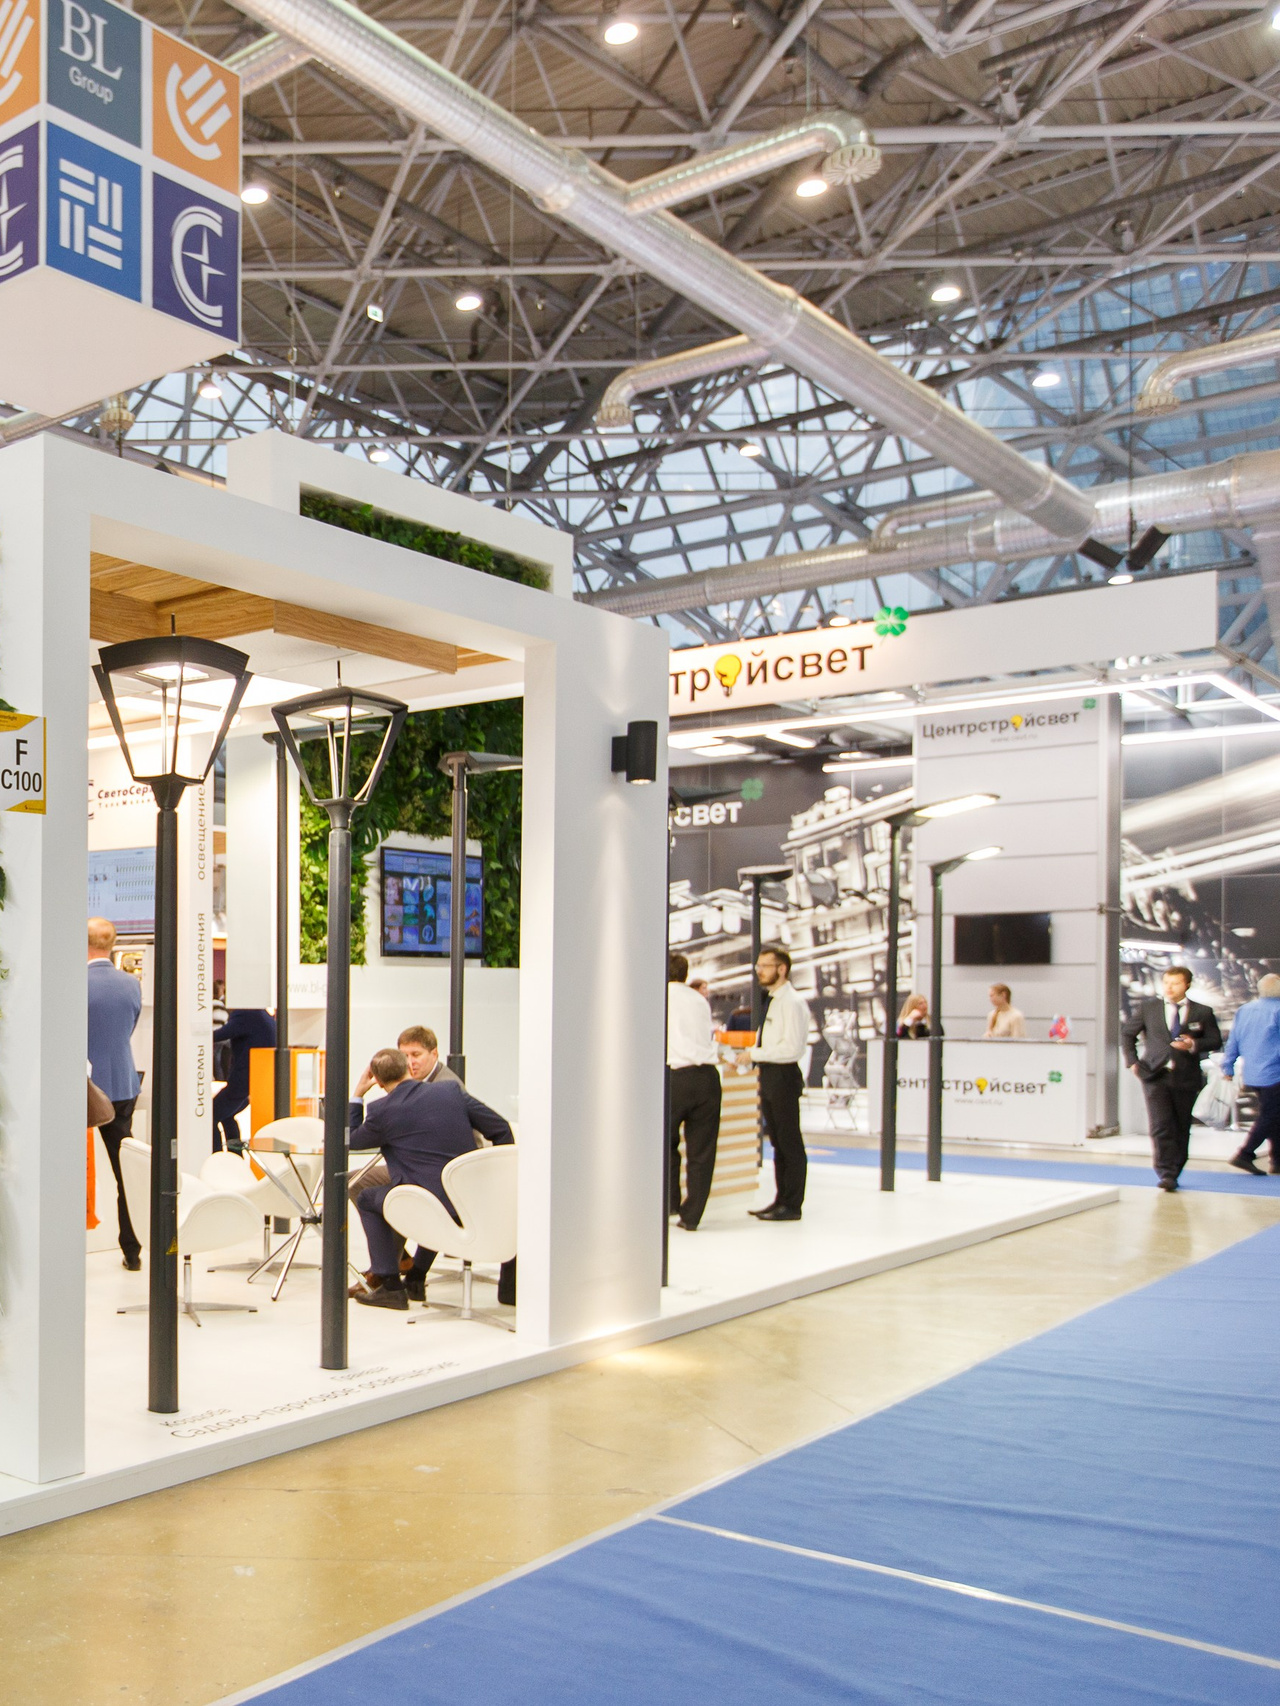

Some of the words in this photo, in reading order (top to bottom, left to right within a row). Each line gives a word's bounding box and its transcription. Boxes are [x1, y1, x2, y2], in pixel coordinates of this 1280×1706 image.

[59, 0, 123, 81] BL
[68, 67, 114, 104] Group
[16, 739, 28, 765] F
[1, 768, 43, 793] C100
[198, 774, 207, 880] освещение
[668, 801, 743, 828] свет
[197, 912, 207, 1012] управления
[194, 1044, 206, 1118] Системы
